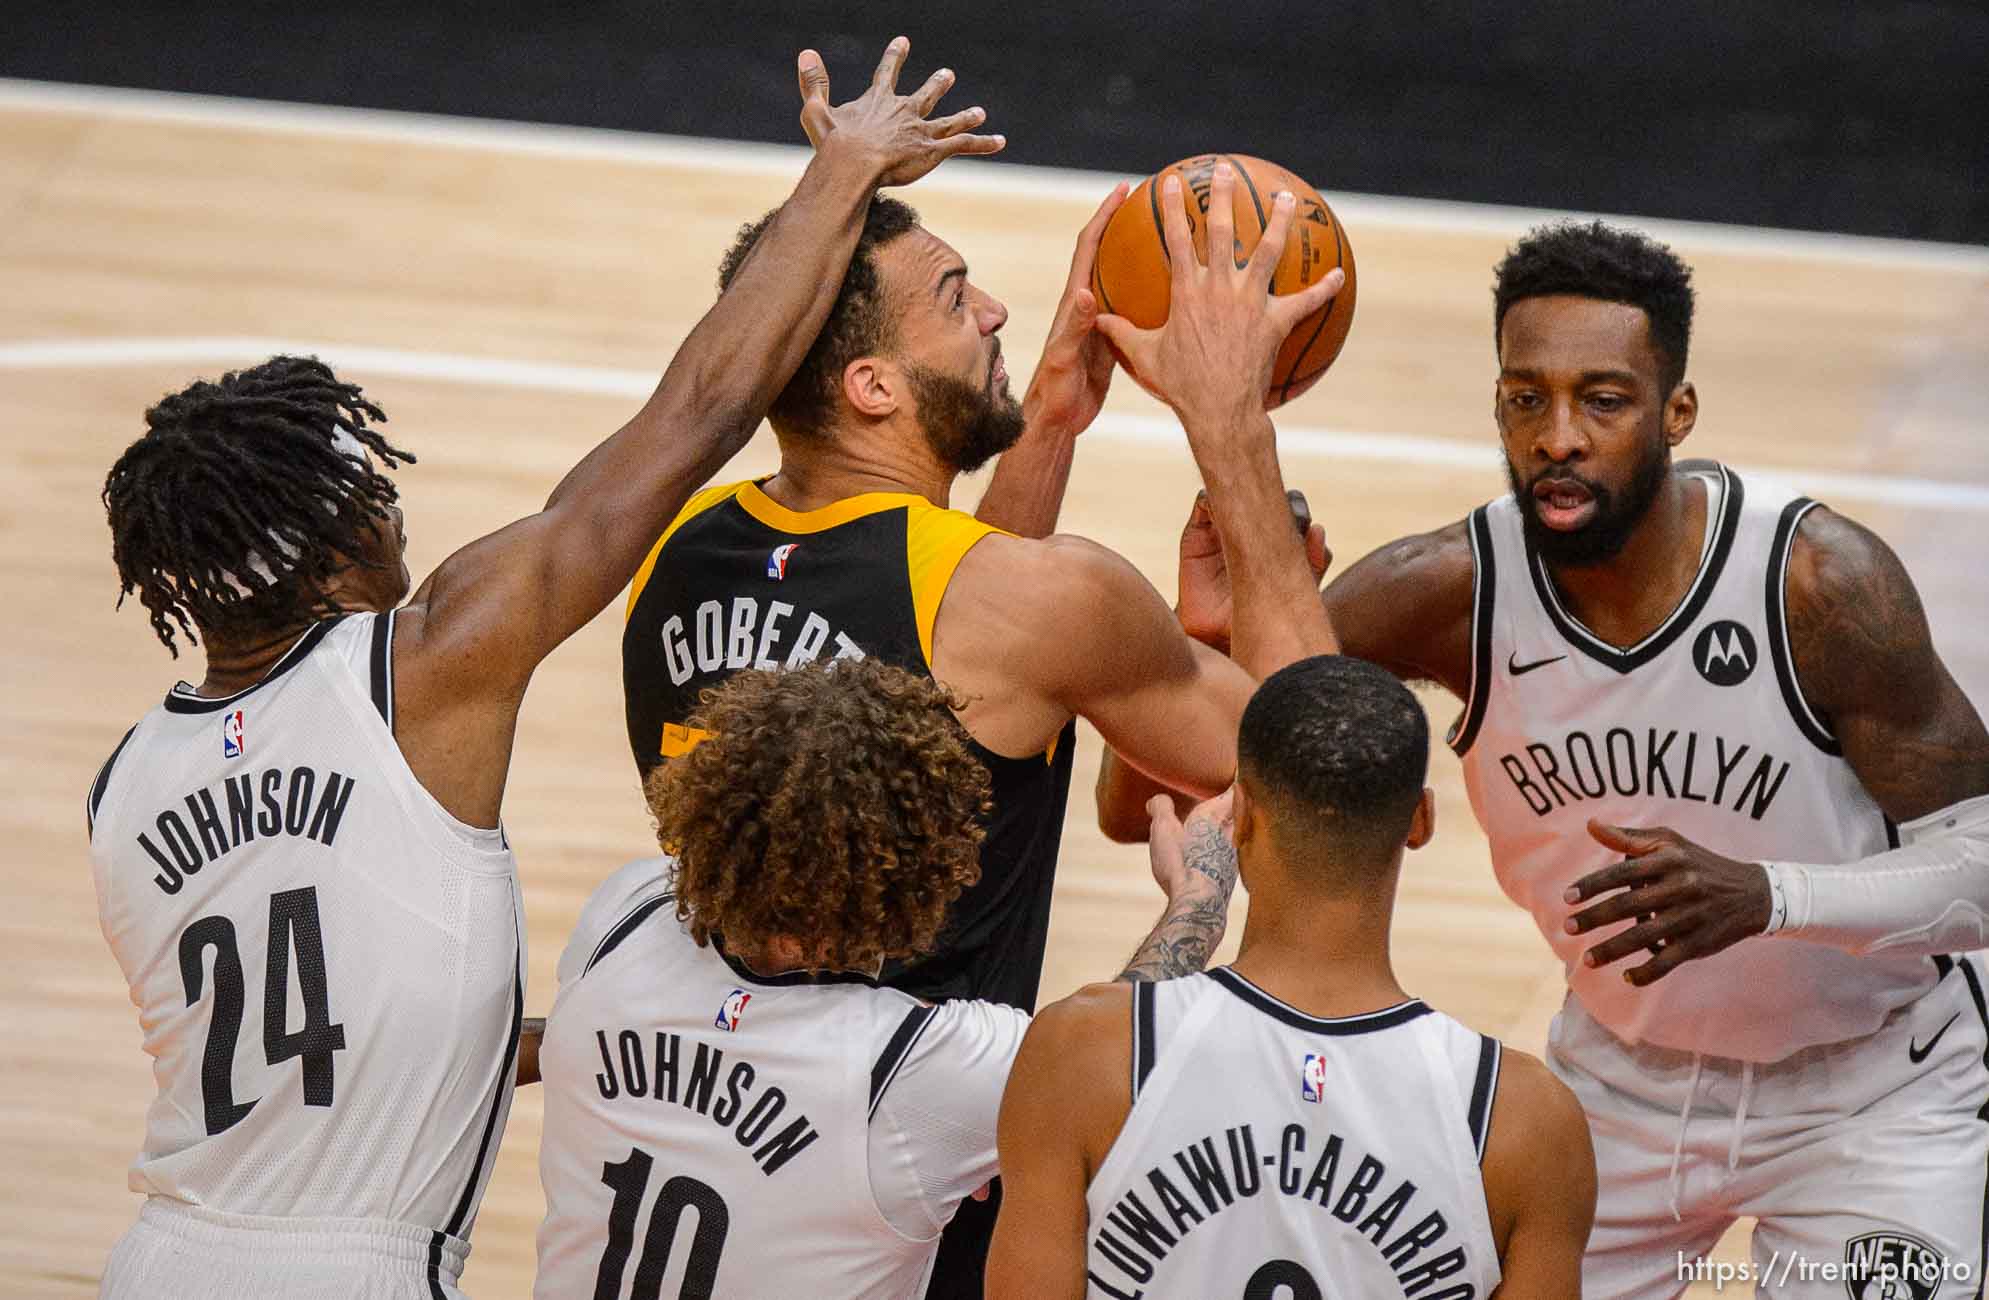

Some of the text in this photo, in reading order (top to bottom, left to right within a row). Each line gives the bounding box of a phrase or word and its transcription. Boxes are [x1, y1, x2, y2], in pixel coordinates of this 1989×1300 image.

[661, 597, 867, 687] GOBERT
[136, 766, 356, 895] JOHNSON
[1500, 727, 1790, 821] BROOKLYN
[178, 885, 346, 1137] 24
[595, 1029, 819, 1177] JOHNSON
[594, 1147, 729, 1300] 10
